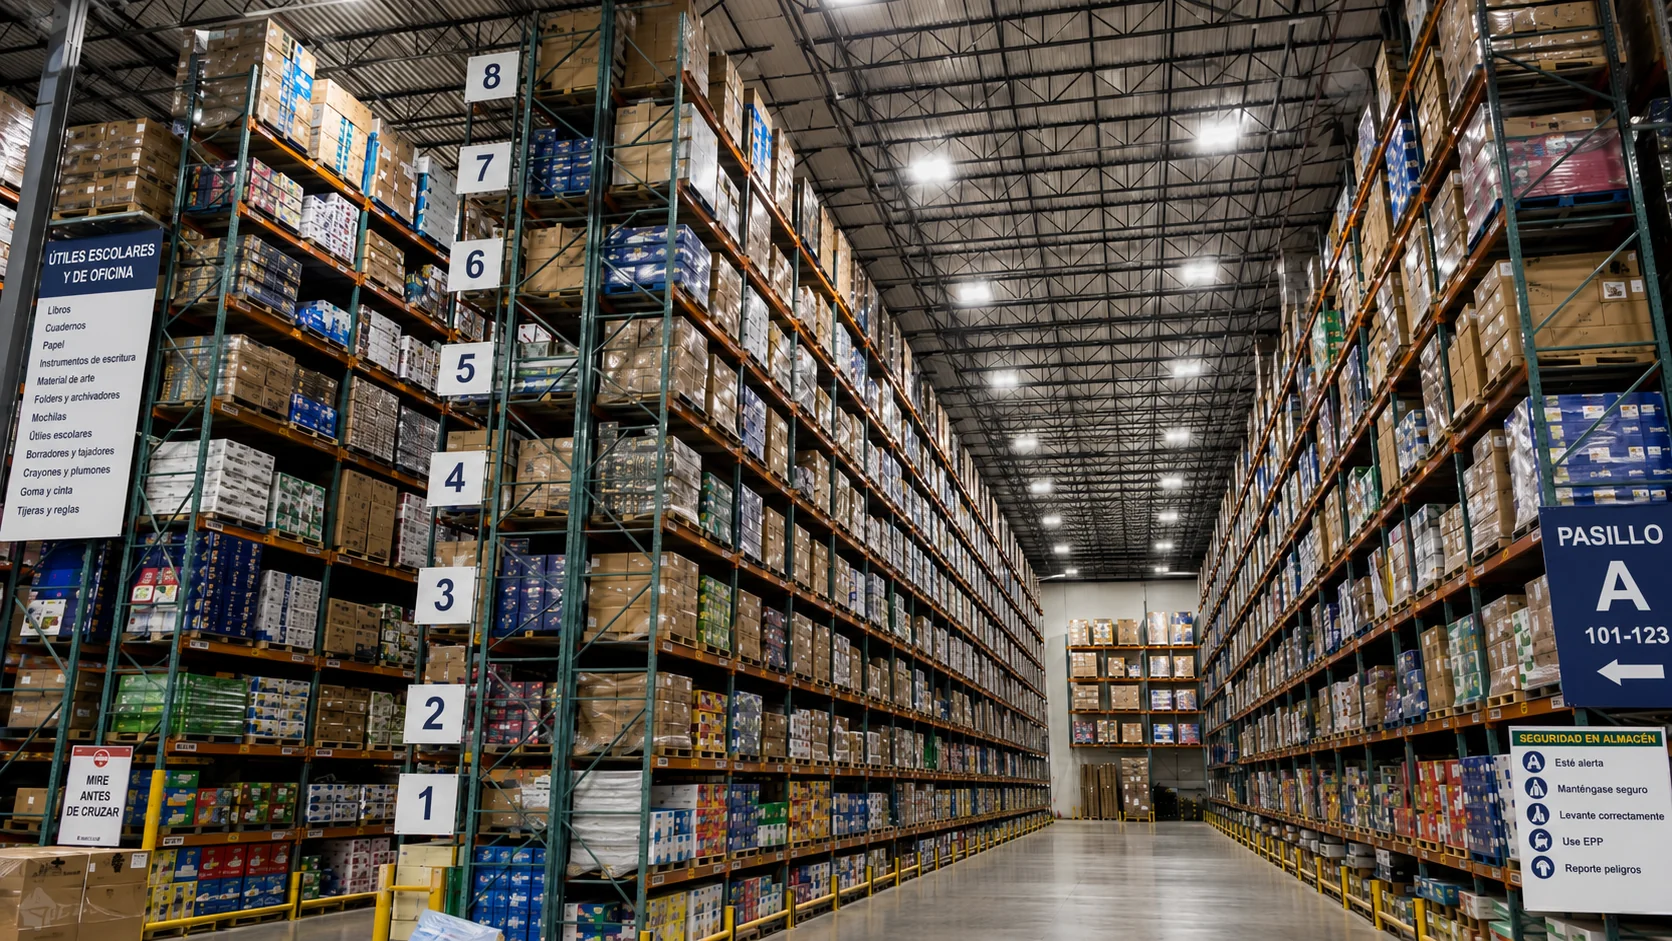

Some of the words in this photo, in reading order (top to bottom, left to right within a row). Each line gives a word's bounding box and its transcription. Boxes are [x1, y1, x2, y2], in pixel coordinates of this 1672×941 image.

[483, 63, 500, 90] 8
[476, 153, 495, 182] 7
[49, 250, 86, 266] ÚTILES
[88, 243, 155, 262] ESCOLARES
[465, 250, 484, 279] 6
[63, 271, 71, 284] Y
[72, 270, 88, 283] DE
[90, 266, 134, 282] OFICINA
[47, 306, 71, 315] Libros
[45, 322, 86, 333] Cuadernos
[42, 340, 65, 351] Papel
[40, 357, 89, 368] Instrumentos
[90, 355, 100, 364] de
[102, 353, 136, 363] escritura
[455, 354, 475, 383] 5
[37, 375, 67, 386] Material
[68, 375, 78, 384] de
[80, 374, 95, 383] arte
[34, 394, 63, 404] Folders
[64, 395, 69, 404] y
[70, 391, 120, 402] archivadores
[31, 412, 67, 422] Mochilas
[53, 430, 92, 439] escolares
[26, 449, 69, 459] Borradores
[71, 450, 76, 459] y
[78, 447, 115, 458] tajadores
[23, 467, 62, 479] Crayones
[63, 469, 69, 478] y
[70, 466, 111, 477] plumones
[444, 462, 466, 493] 4
[20, 487, 44, 496] Goma
[46, 488, 51, 497] y
[53, 486, 73, 495] cinta
[17, 506, 45, 517] Tijeras
[46, 507, 52, 517] y
[53, 505, 80, 516] reglas
[1557, 524, 1664, 546] PASILLO
[1596, 560, 1651, 611] A
[434, 578, 455, 611] 3
[1585, 626, 1670, 644] 101-123
[422, 697, 445, 730] 2
[1519, 733, 1582, 744] SEGURIDAD
[1585, 734, 1600, 744] EN
[1603, 732, 1657, 744] ALMACÉN
[1555, 757, 1576, 768] Esté
[1578, 758, 1604, 768] alerta
[86, 775, 110, 786] MIRE
[80, 790, 111, 801] ANTES
[1557, 784, 1613, 796] Manténgase
[1615, 786, 1648, 796] seguro
[418, 786, 433, 821] 1
[66, 806, 79, 817] DE
[81, 806, 120, 817] CRUZAR
[1559, 810, 1596, 820] Levante
[1598, 812, 1665, 821] correctamente
[1562, 837, 1581, 846] Use
[1583, 837, 1604, 846] EPP
[1565, 864, 1601, 875] Reporte
[1604, 864, 1642, 876] peligros
